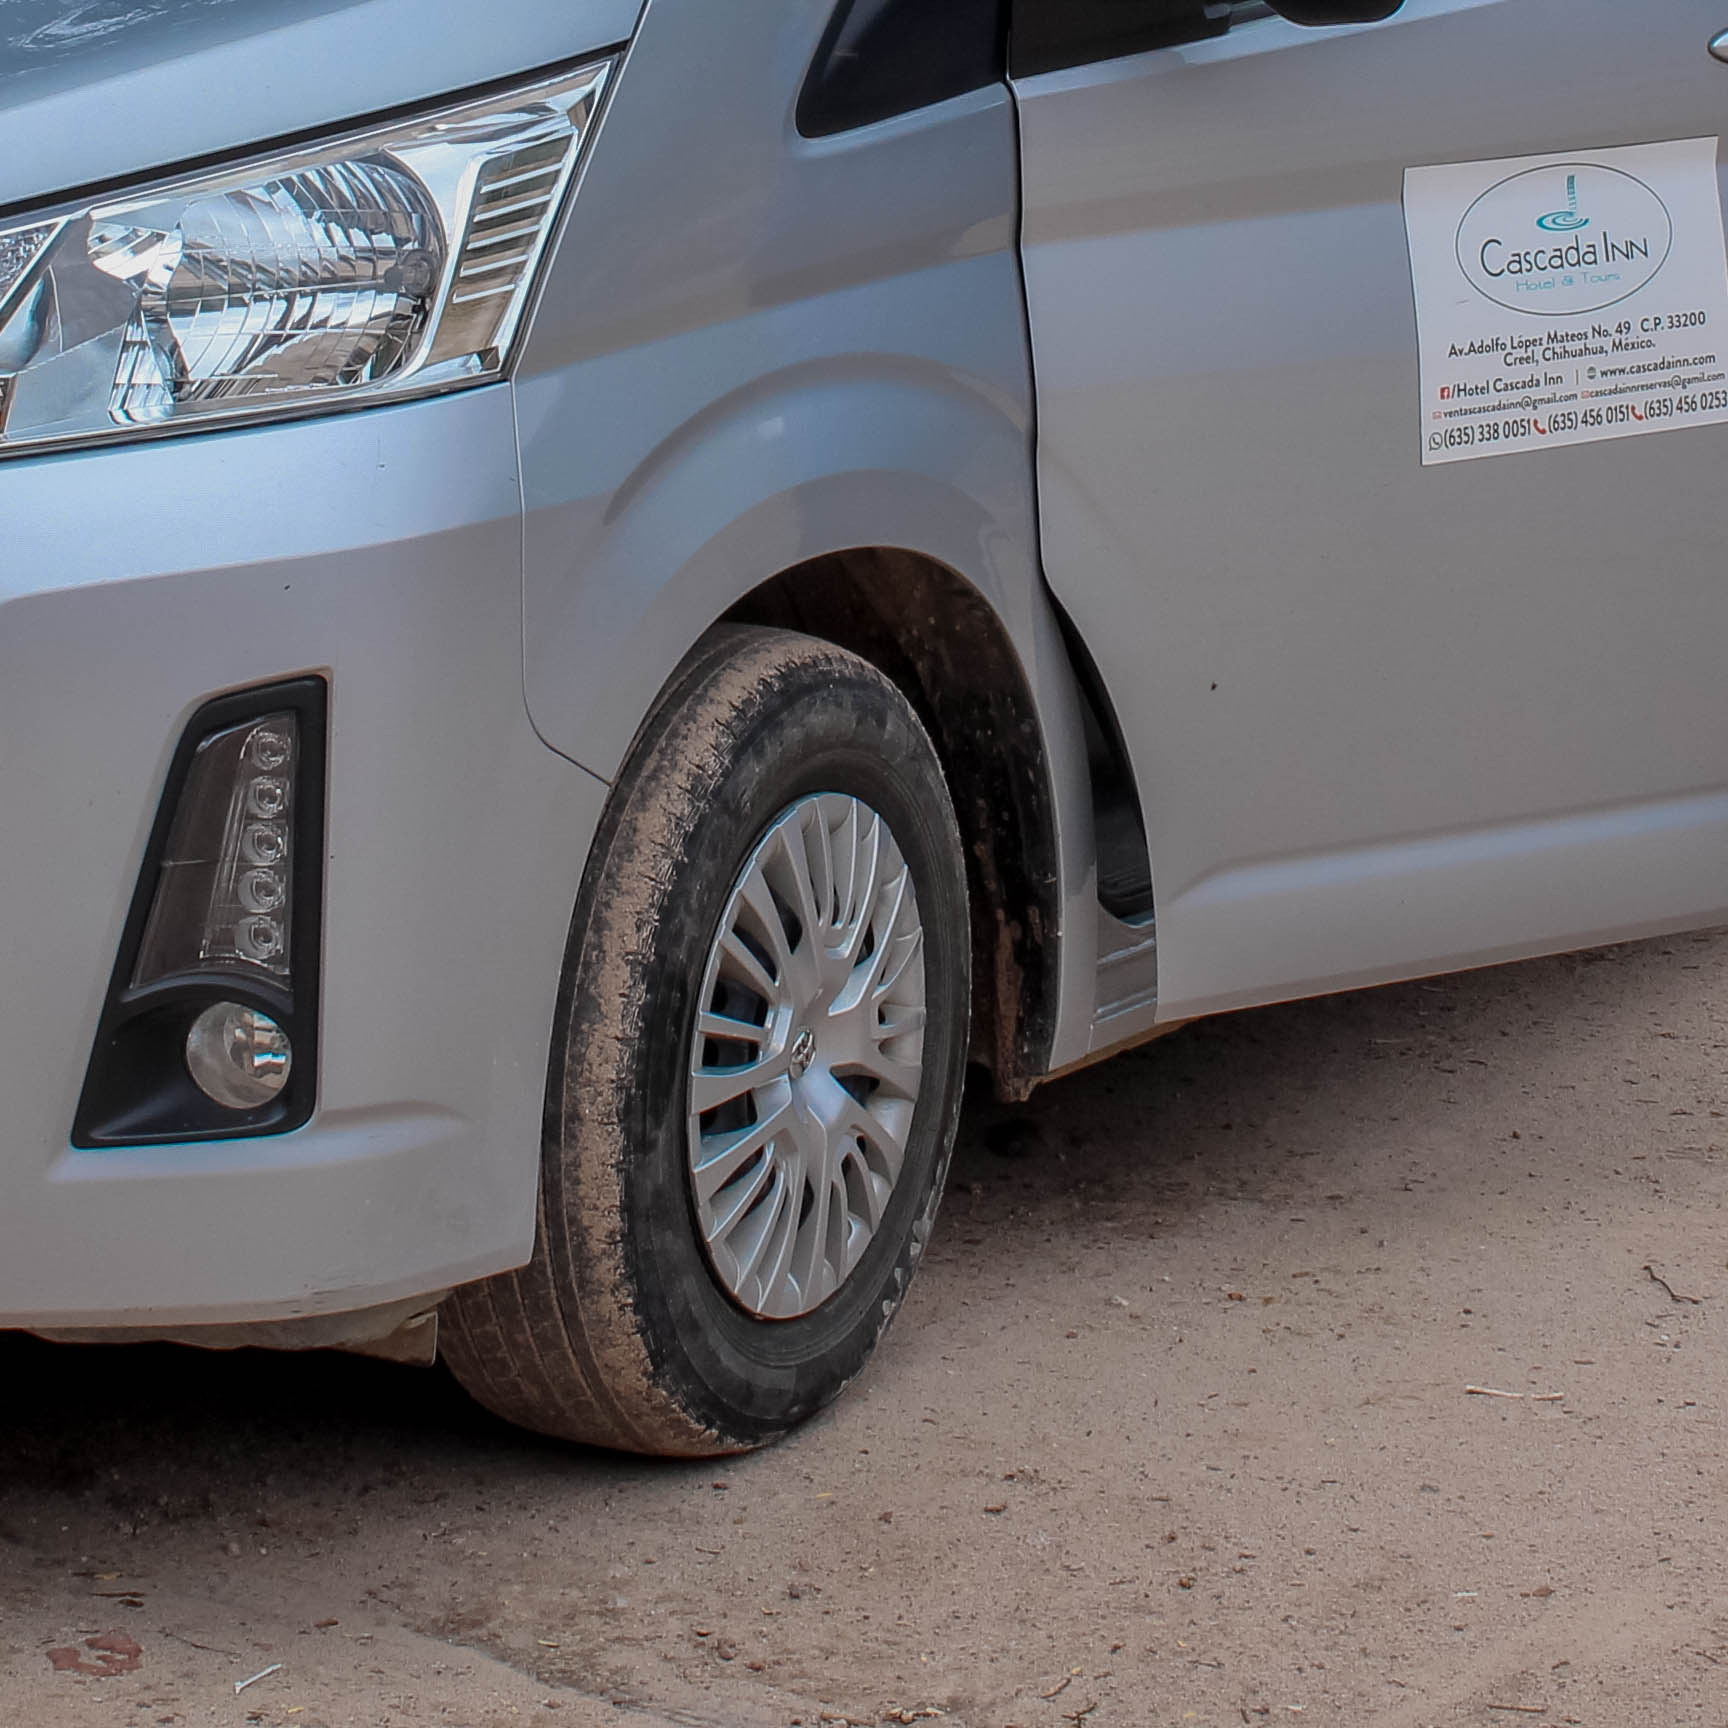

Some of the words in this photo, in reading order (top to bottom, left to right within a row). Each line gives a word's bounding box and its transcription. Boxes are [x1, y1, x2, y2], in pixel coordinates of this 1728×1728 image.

[1480, 234, 1598, 278] Cascada
[1516, 277, 1555, 292] Hotel
[1583, 271, 1621, 284] Tours
[1510, 334, 1543, 353] López
[1547, 329, 1588, 345] Mateos
[1592, 324, 1612, 339] No.
[1615, 321, 1631, 335] 49
[1667, 311, 1706, 329] 33200
[1503, 349, 1539, 367] Creel,
[1542, 341, 1608, 361] Chihuahua,
[1600, 354, 1716, 378] www.cascadainn.com
[1493, 373, 1540, 392] Cascada
[1544, 372, 1563, 386] Inn
[1443, 391, 1578, 419] ventascascadainn@gmail.com
[1548, 411, 1578, 434] (635)
[1581, 407, 1603, 427] 456
[1606, 403, 1630, 423] 0151
[1644, 397, 1673, 420] (635)
[1676, 393, 1697, 413] 456
[1700, 390, 1728, 409] 0253
[1444, 426, 1475, 449] (635)
[1478, 422, 1499, 443] 338
[1503, 418, 1531, 439] 0051
